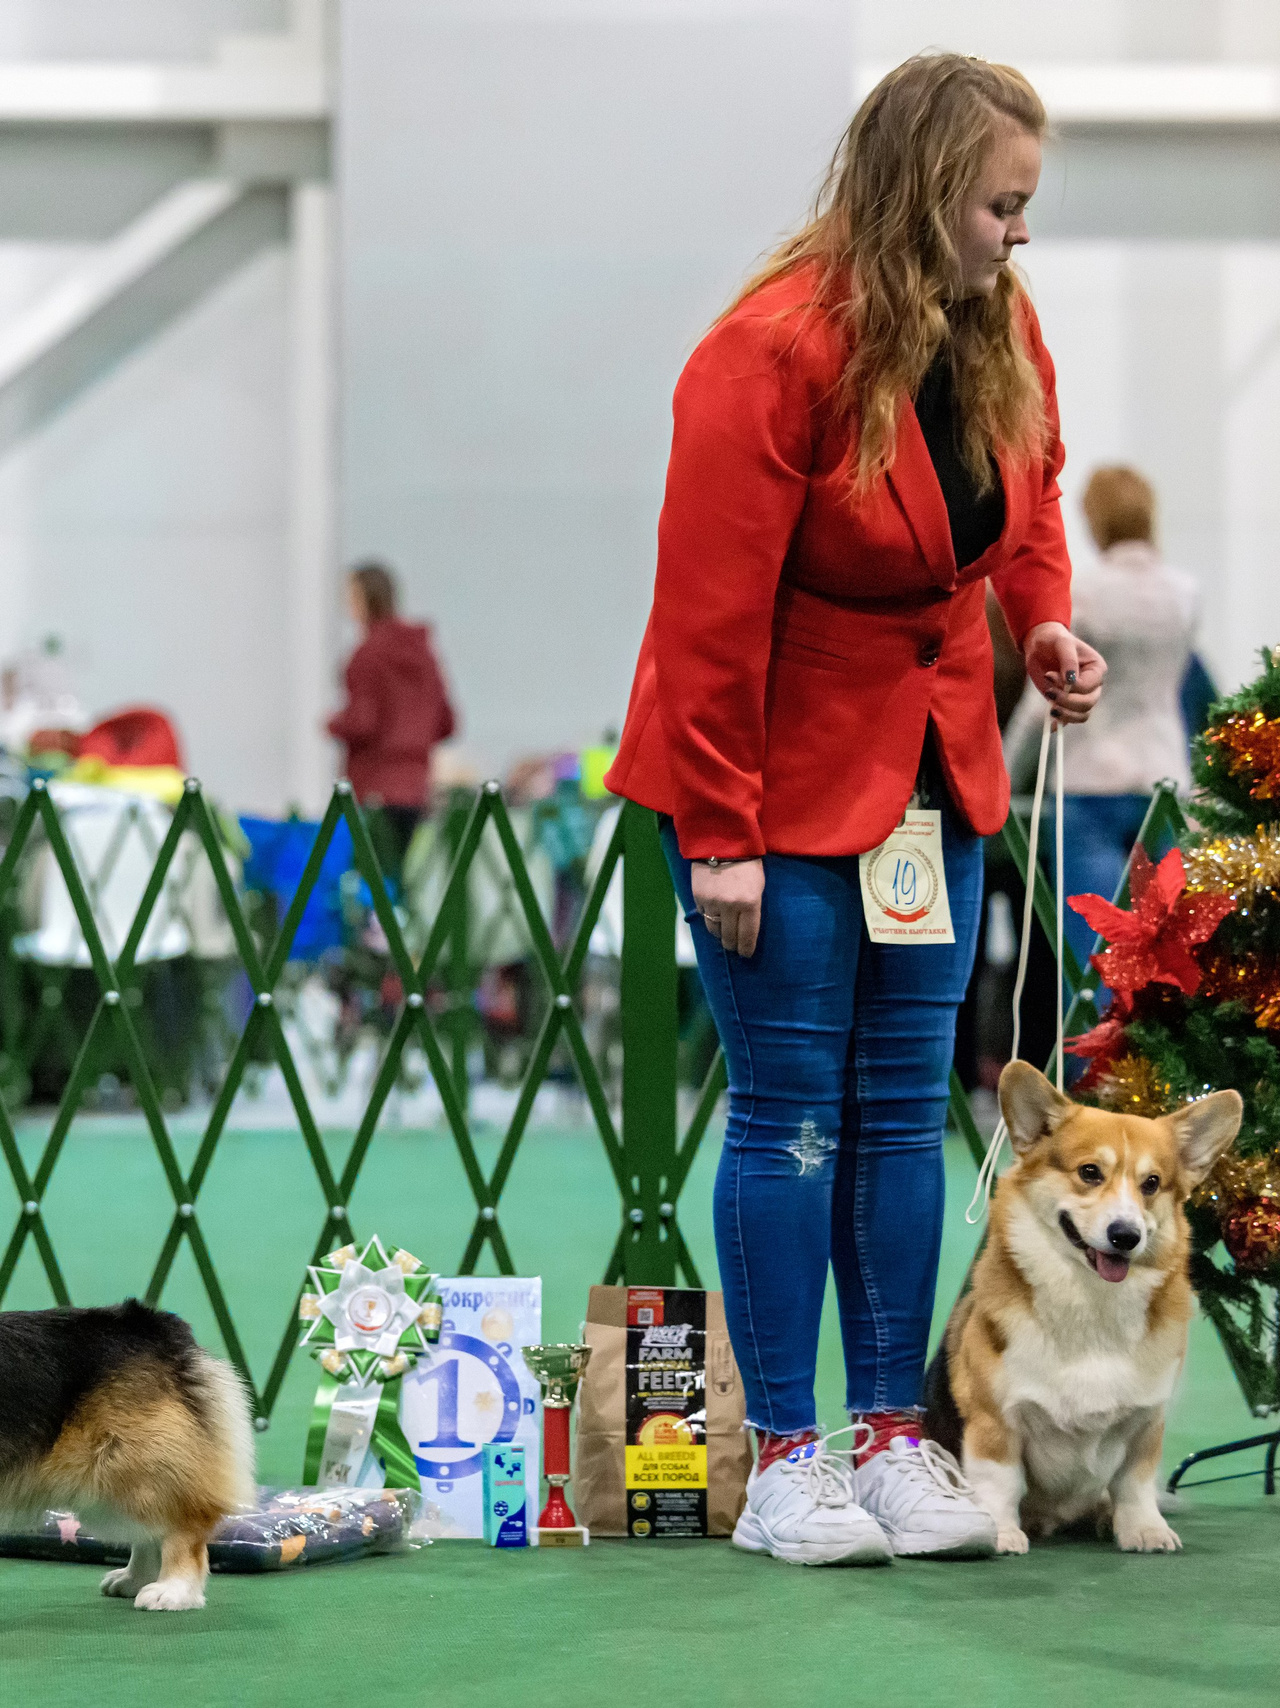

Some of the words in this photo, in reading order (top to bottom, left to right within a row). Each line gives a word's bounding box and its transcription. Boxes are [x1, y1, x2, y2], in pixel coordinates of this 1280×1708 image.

[892, 858, 917, 905] 19
[638, 1347, 693, 1360] FARM
[638, 1371, 693, 1391] FEED
[416, 1359, 476, 1448] 1
[637, 1452, 654, 1461] ALL
[658, 1451, 696, 1461] BREEDS
[642, 1463, 658, 1471] ДЛЯ
[660, 1463, 690, 1471] СОБАК
[633, 1473, 659, 1481] ВСЕХ
[662, 1473, 700, 1482] ПОРОД
